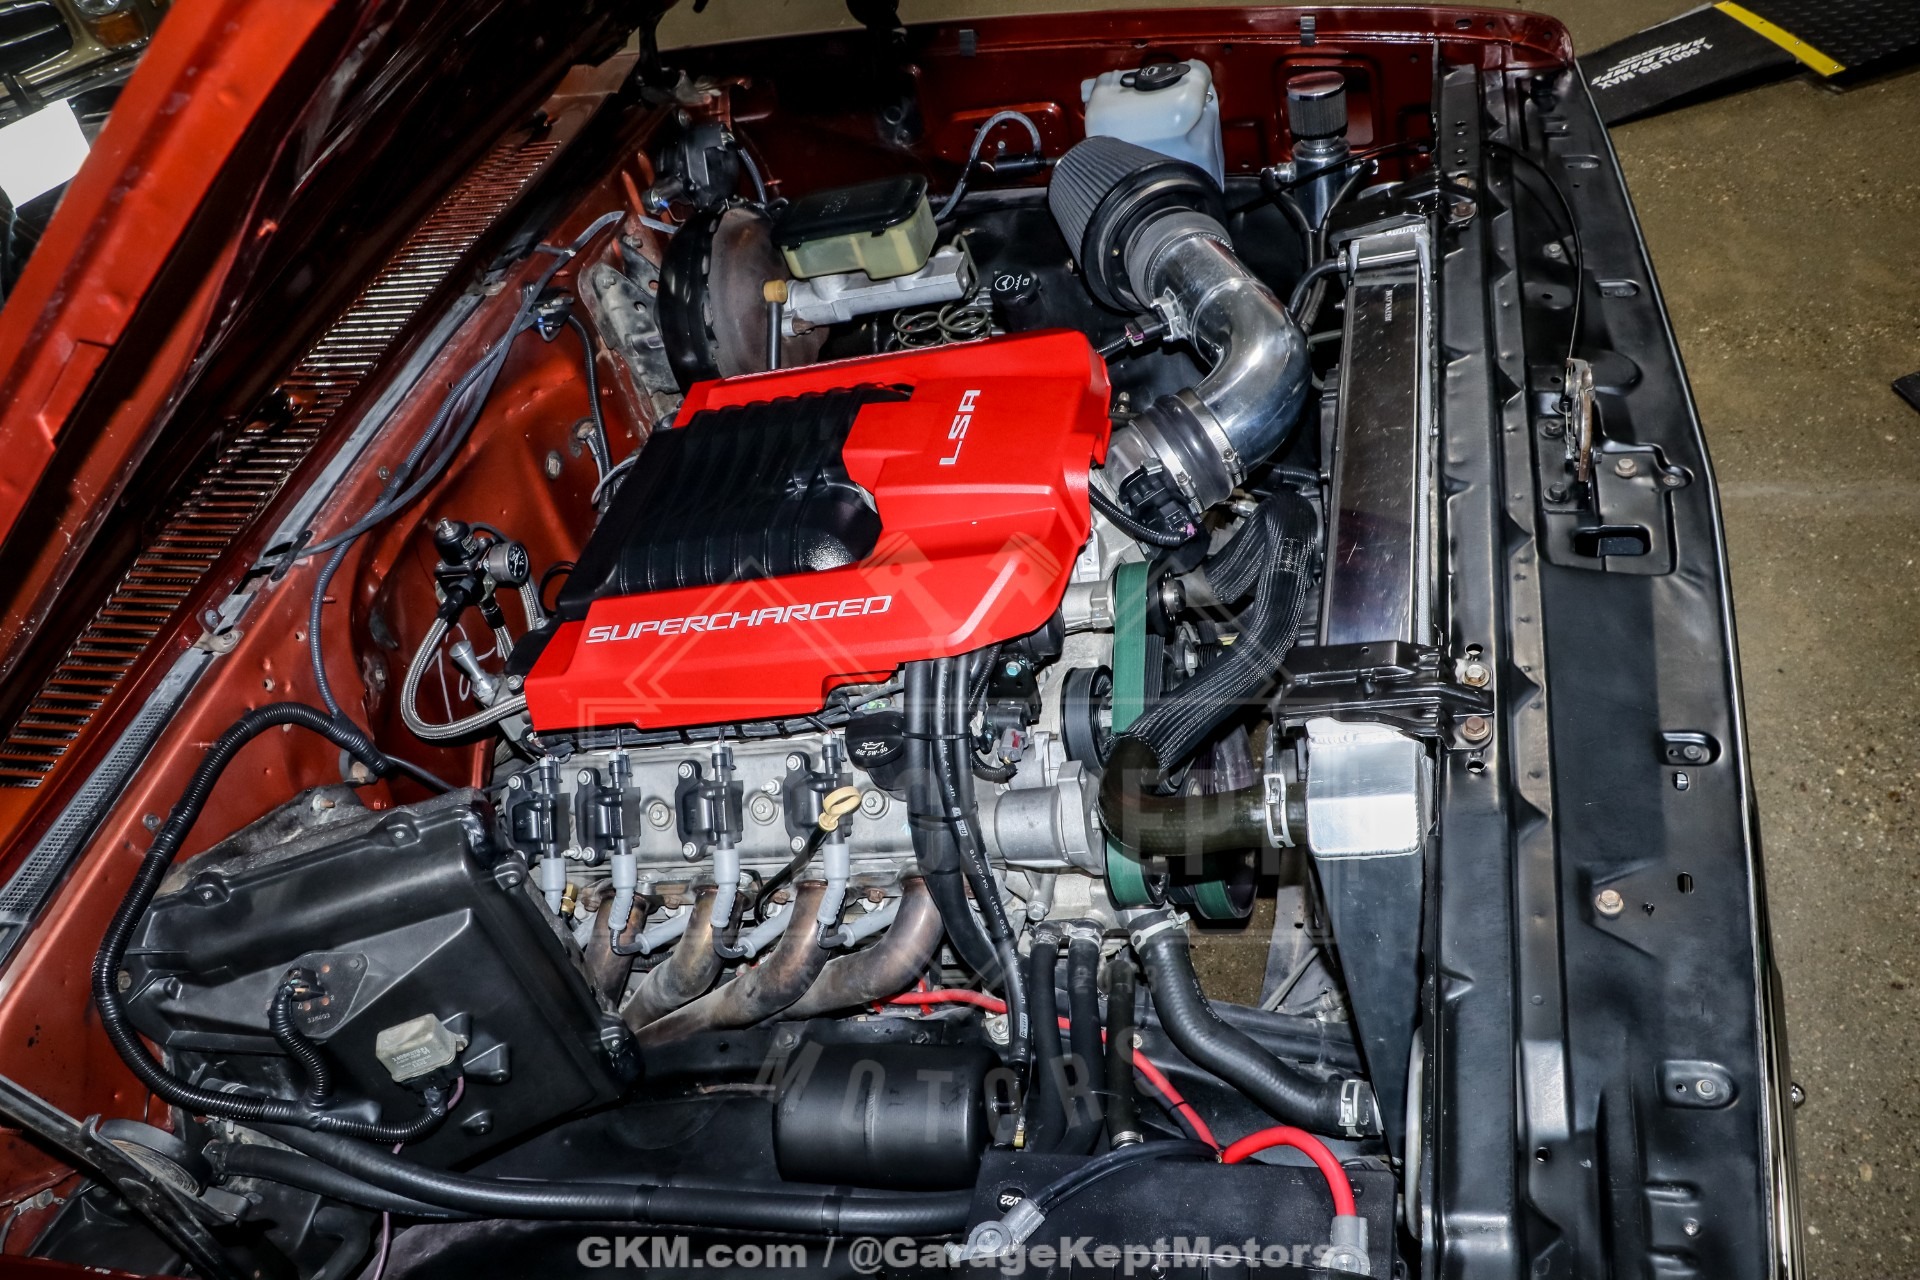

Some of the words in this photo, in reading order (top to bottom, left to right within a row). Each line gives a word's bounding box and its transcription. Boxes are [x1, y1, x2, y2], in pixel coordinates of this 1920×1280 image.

[1658, 36, 1706, 60] RACE
[1671, 43, 1713, 62] 1,500
[1590, 56, 1655, 86] RAMPS
[939, 389, 981, 466] LSA
[586, 595, 893, 644] SUPERCHARGED
[855, 748, 867, 756] SAE
[866, 746, 888, 756] 5W-30
